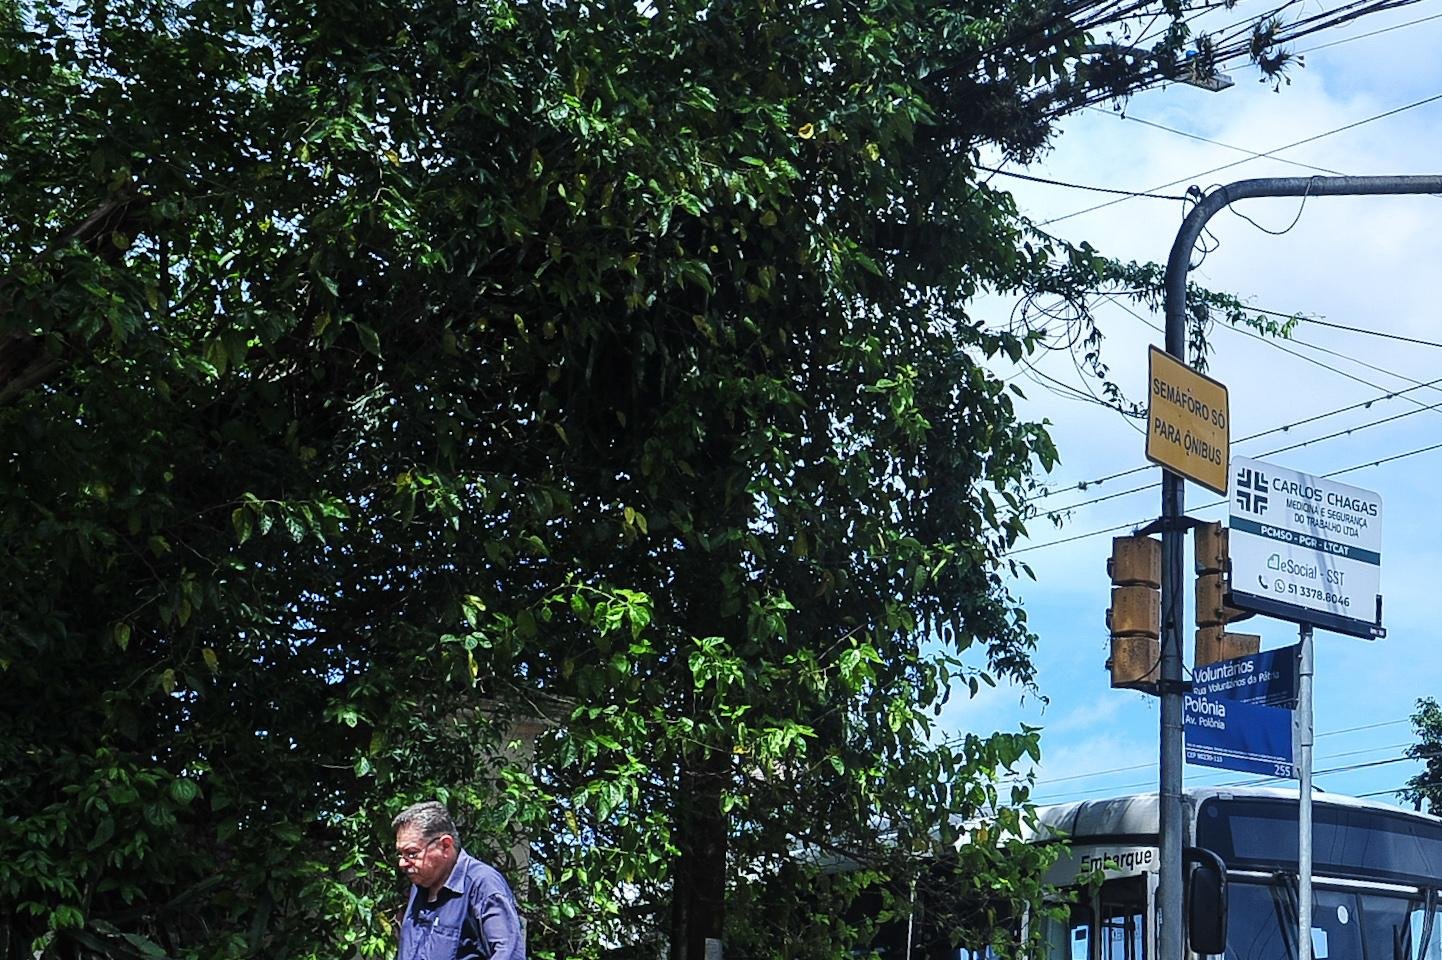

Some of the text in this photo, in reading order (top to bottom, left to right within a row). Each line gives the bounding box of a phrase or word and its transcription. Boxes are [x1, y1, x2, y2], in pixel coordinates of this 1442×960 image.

[1153, 378, 1226, 430] SEMÁFORO SÓ
[1154, 417, 1222, 466] PARA ÔNIBUS
[1272, 477, 1378, 517] CARLOS CHAGAS
[1286, 498, 1368, 528] MEDICINA E SEGURANÇA
[1294, 512, 1360, 539] DO TRABALHO LTDA
[1261, 525, 1293, 541] PCMSO
[1299, 535, 1318, 548] PGR
[1324, 541, 1350, 556] LTCAT
[1280, 559, 1317, 580] eSocial
[1326, 569, 1345, 586] SST
[1288, 584, 1350, 607] 51 3378.8046
[1193, 660, 1254, 684] Voluntários
[1193, 686, 1207, 696] Rua
[1208, 678, 1246, 693] Voluntários
[1247, 674, 1257, 684] da
[1184, 695, 1226, 717] Polônia
[1185, 715, 1226, 730] Av. Polônia
[1274, 764, 1291, 777] 255
